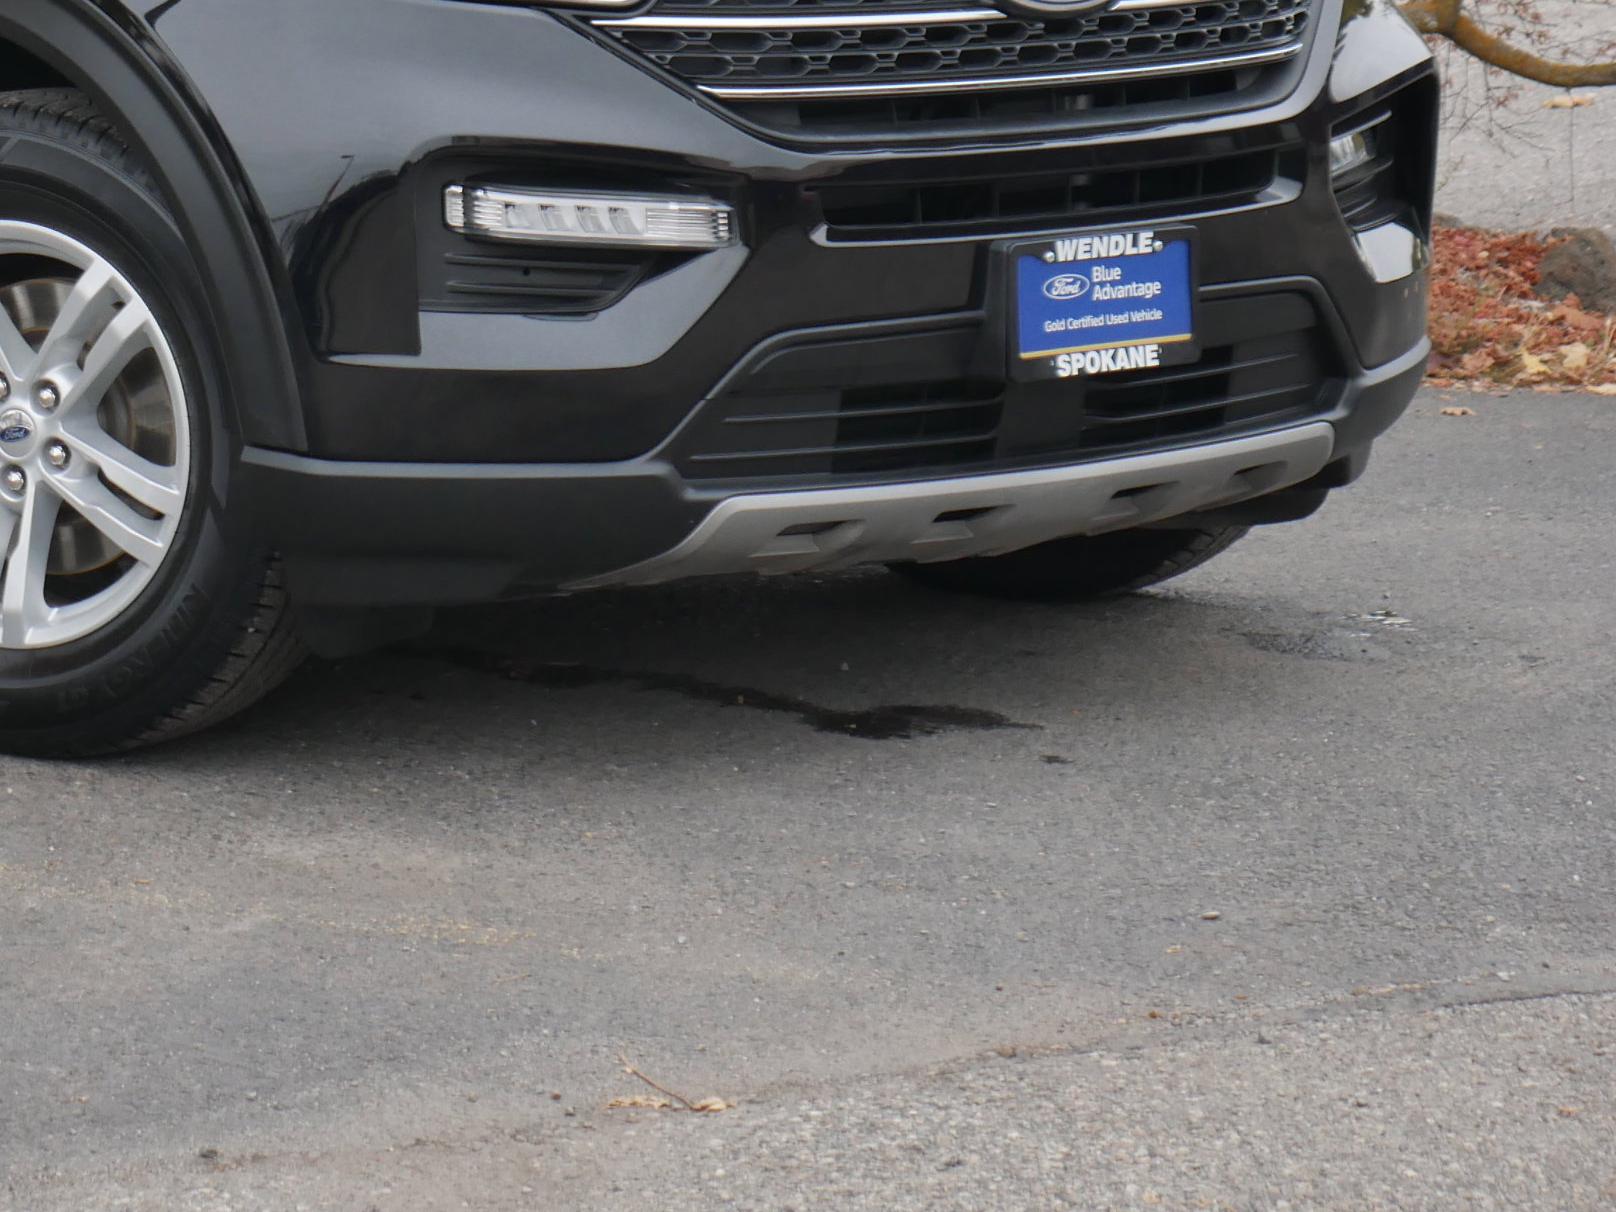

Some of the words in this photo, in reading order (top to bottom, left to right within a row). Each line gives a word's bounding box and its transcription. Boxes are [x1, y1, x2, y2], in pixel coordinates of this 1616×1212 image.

[1055, 232, 1155, 263] WENDLE
[1092, 265, 1122, 282] Blue
[1092, 281, 1162, 301] Advantage
[1044, 319, 1066, 332] Gold
[1067, 315, 1104, 329] Certified
[1106, 312, 1129, 325] Used
[1131, 309, 1163, 322] Vehicle
[1056, 344, 1160, 378] SPOKANE
